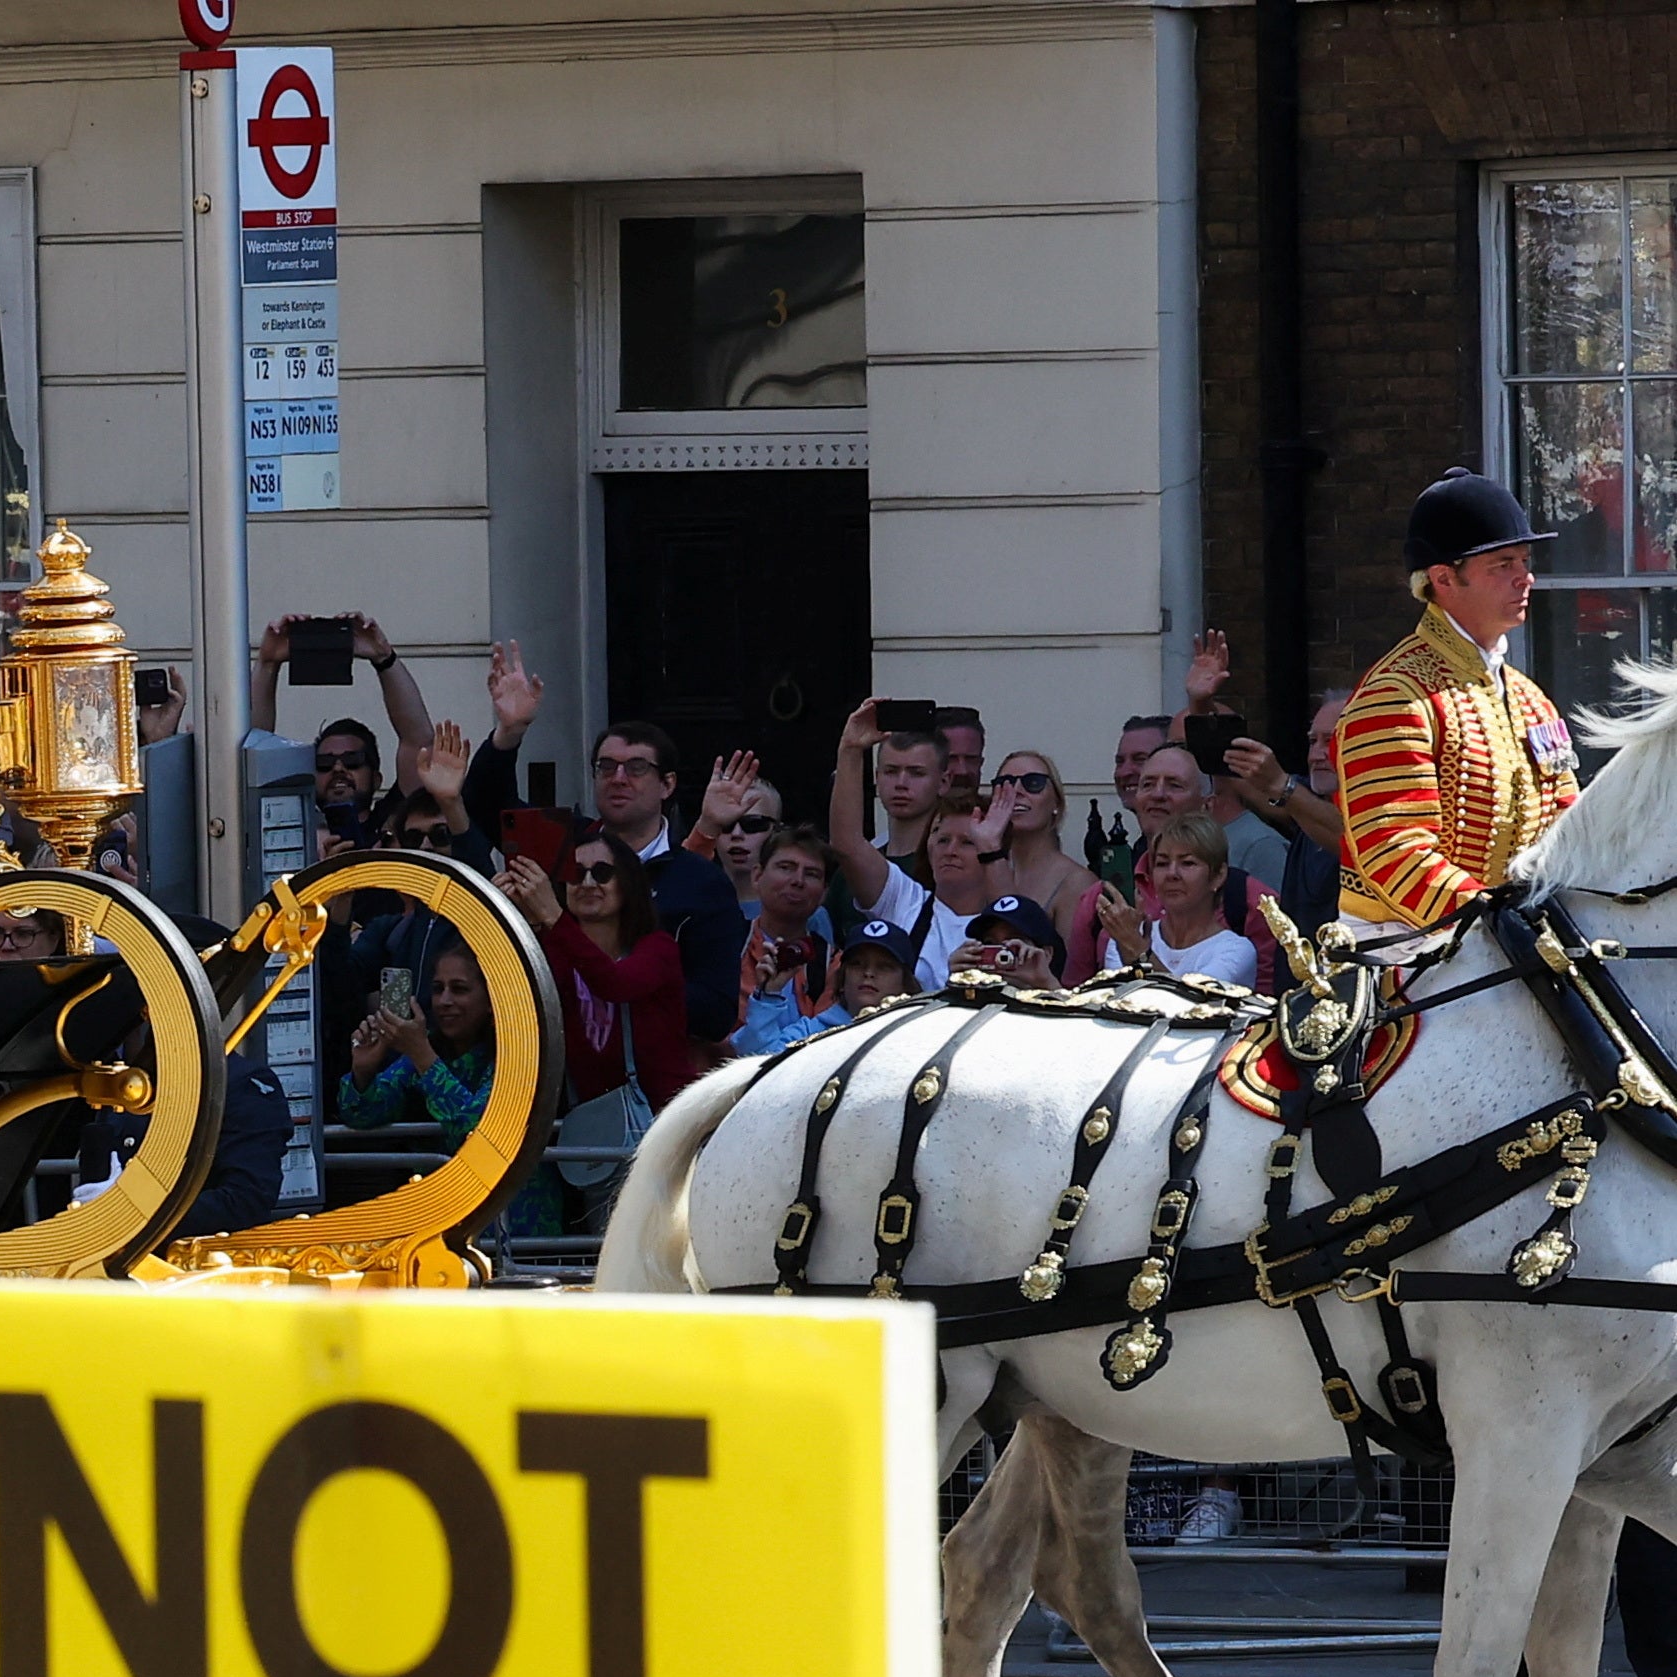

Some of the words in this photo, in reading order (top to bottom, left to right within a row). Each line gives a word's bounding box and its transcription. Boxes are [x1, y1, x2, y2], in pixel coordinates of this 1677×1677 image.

[276, 212, 291, 225] BUS
[294, 211, 312, 224] STOP
[246, 239, 299, 254] Westminster
[301, 237, 327, 251] Station
[267, 259, 299, 271] Parliament
[300, 258, 319, 270] Square
[262, 301, 290, 313] towards
[291, 300, 325, 313] Kennington
[767, 287, 787, 328] 3
[261, 321, 269, 331] or
[270, 318, 300, 332] Elephant
[301, 318, 306, 329] &
[307, 317, 326, 329] Castle
[256, 360, 269, 380] 12
[287, 359, 306, 379] 159
[316, 358, 335, 378] 453
[251, 419, 277, 439] N53
[281, 415, 311, 436] N109
[312, 414, 338, 434] N155
[250, 473, 281, 494] N381
